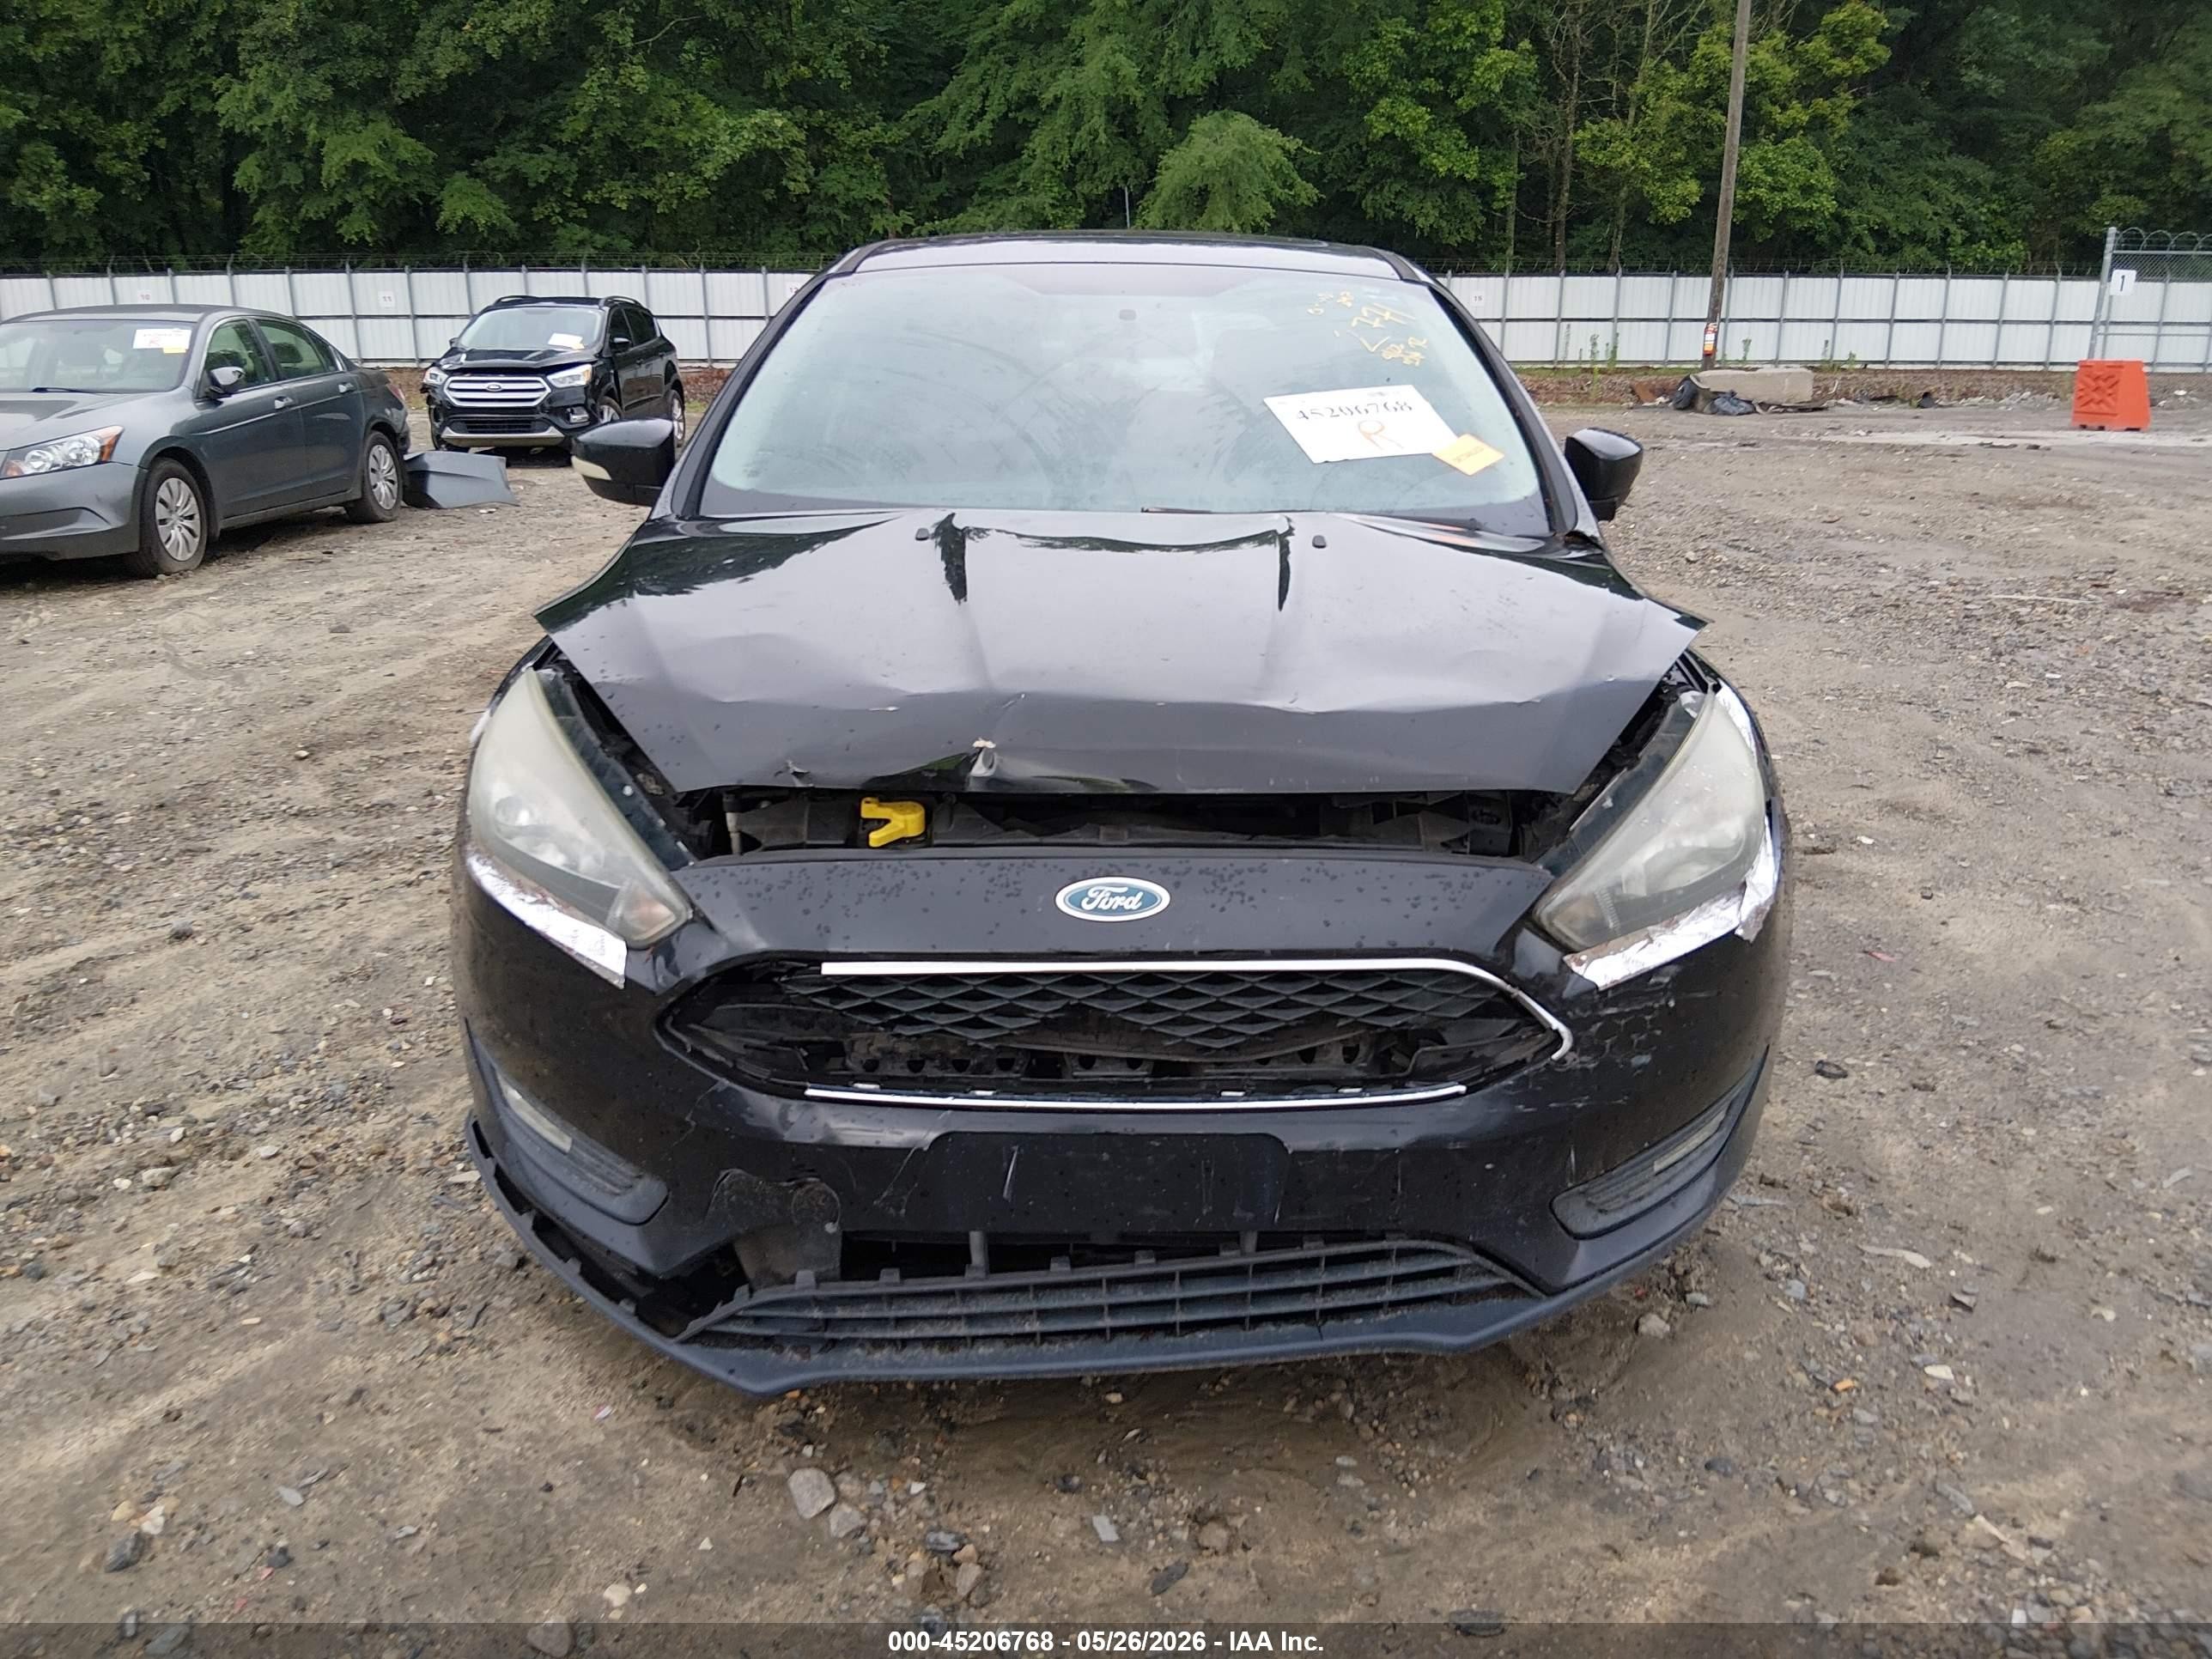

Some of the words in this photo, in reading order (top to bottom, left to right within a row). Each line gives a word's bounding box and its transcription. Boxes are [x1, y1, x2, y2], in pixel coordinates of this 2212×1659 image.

[2119, 274, 2125, 292] 1
[1297, 401, 1413, 420] 45206768
[1080, 885, 1144, 911] Ford
